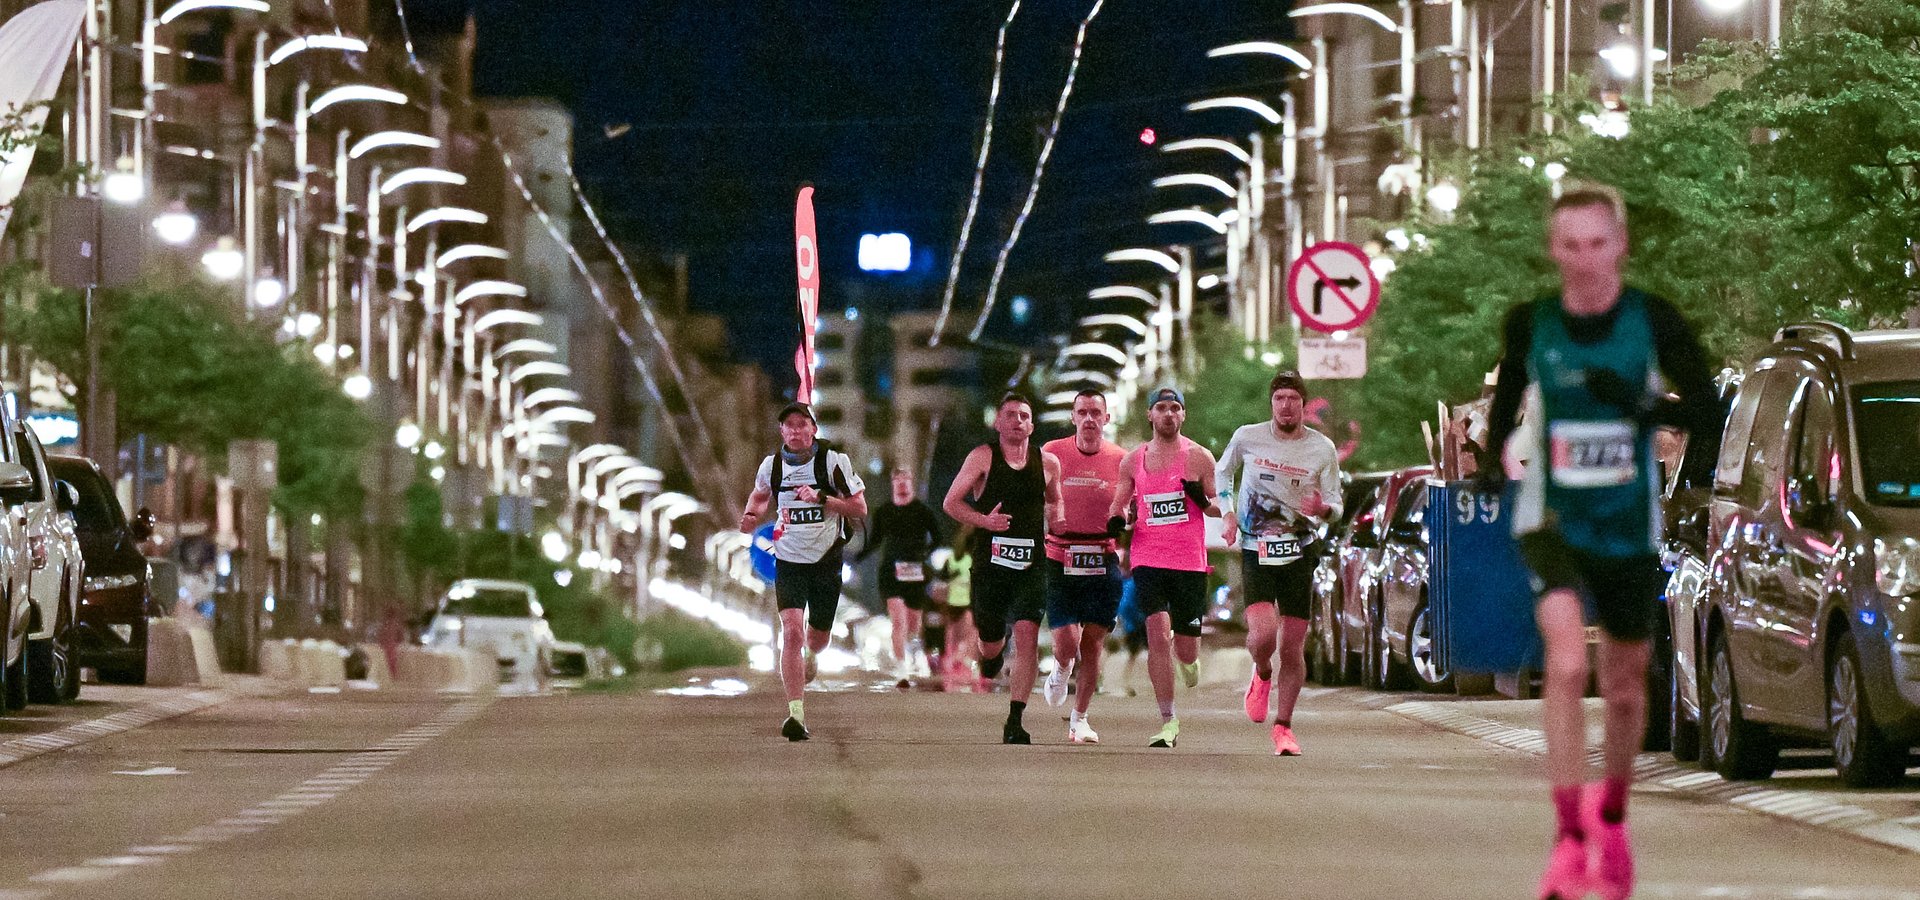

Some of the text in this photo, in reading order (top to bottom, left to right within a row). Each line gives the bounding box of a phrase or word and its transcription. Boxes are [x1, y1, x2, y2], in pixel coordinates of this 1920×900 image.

[1153, 501, 1185, 515] 4062
[1456, 489, 1500, 525] 99
[790, 510, 822, 521] 4112
[1000, 546, 1032, 560] 2431
[1267, 542, 1301, 555] 4554
[1074, 554, 1104, 566] 1143
